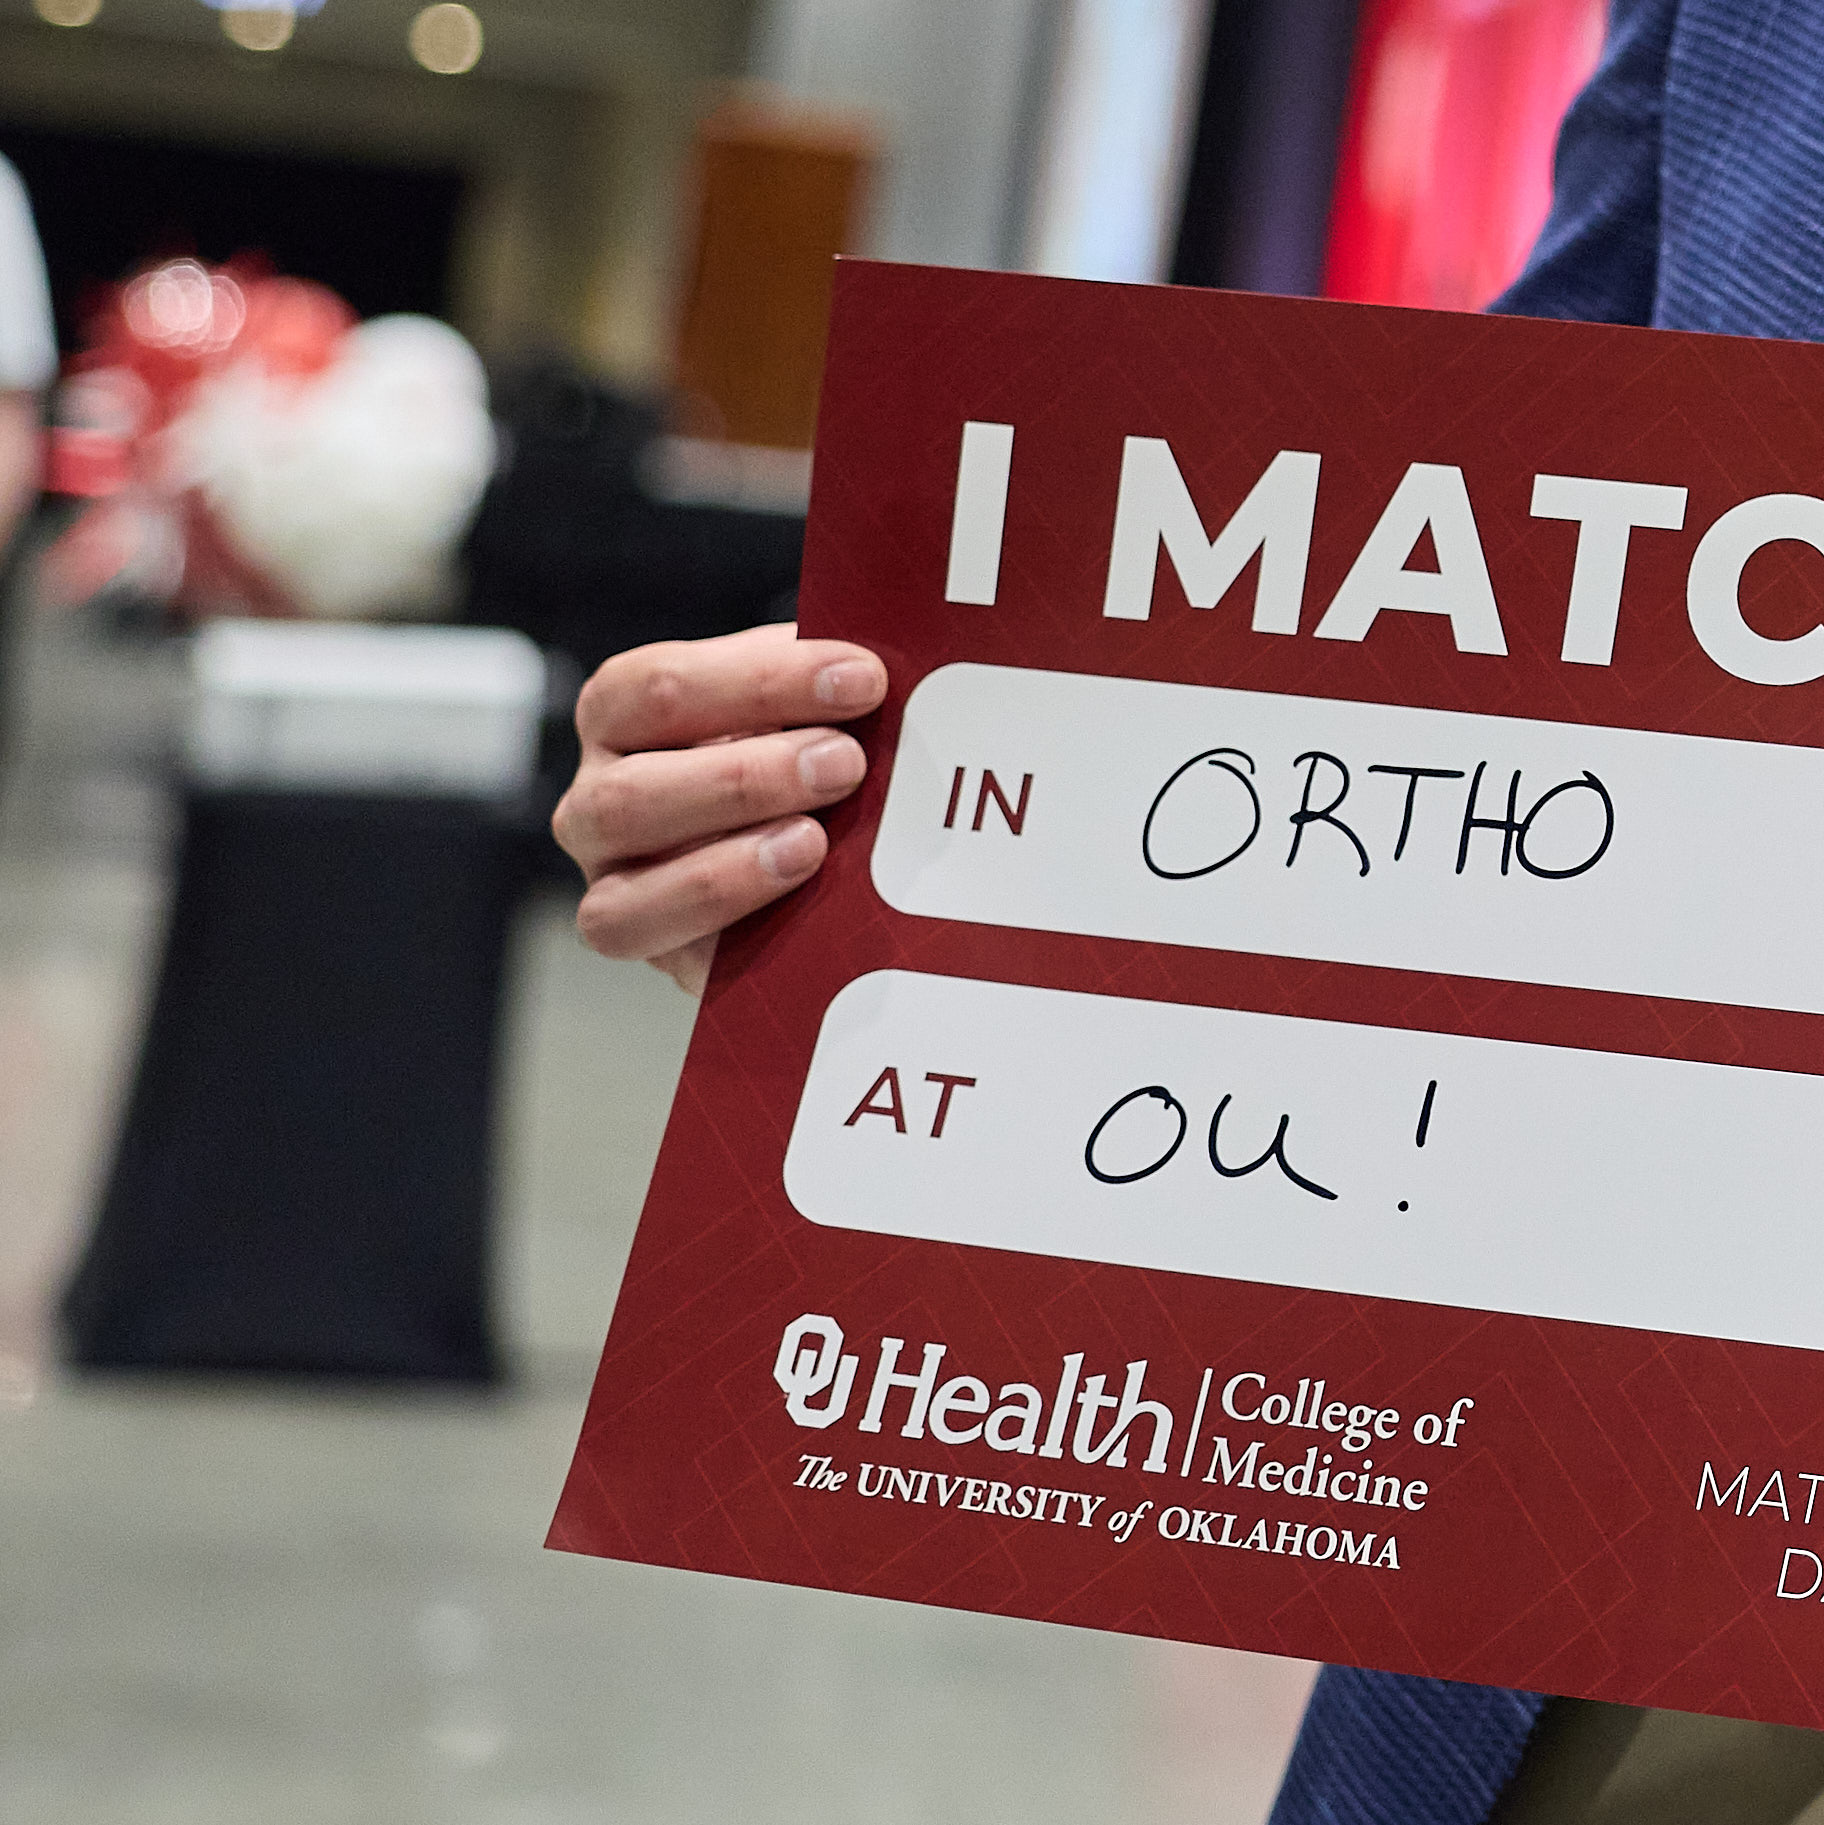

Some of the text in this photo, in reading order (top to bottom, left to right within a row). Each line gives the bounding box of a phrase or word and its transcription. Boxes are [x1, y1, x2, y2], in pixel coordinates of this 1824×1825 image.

[944, 420, 1015, 606] I
[943, 766, 1034, 837] IN
[1142, 747, 1615, 880] ORTHO
[843, 1066, 977, 1139] AT
[857, 1336, 1174, 1474] Health
[1221, 1372, 1475, 1453] College of
[792, 1454, 1401, 1570] The UNIVERSITY of OKLAHOMA
[1201, 1436, 1429, 1511] Medicine
